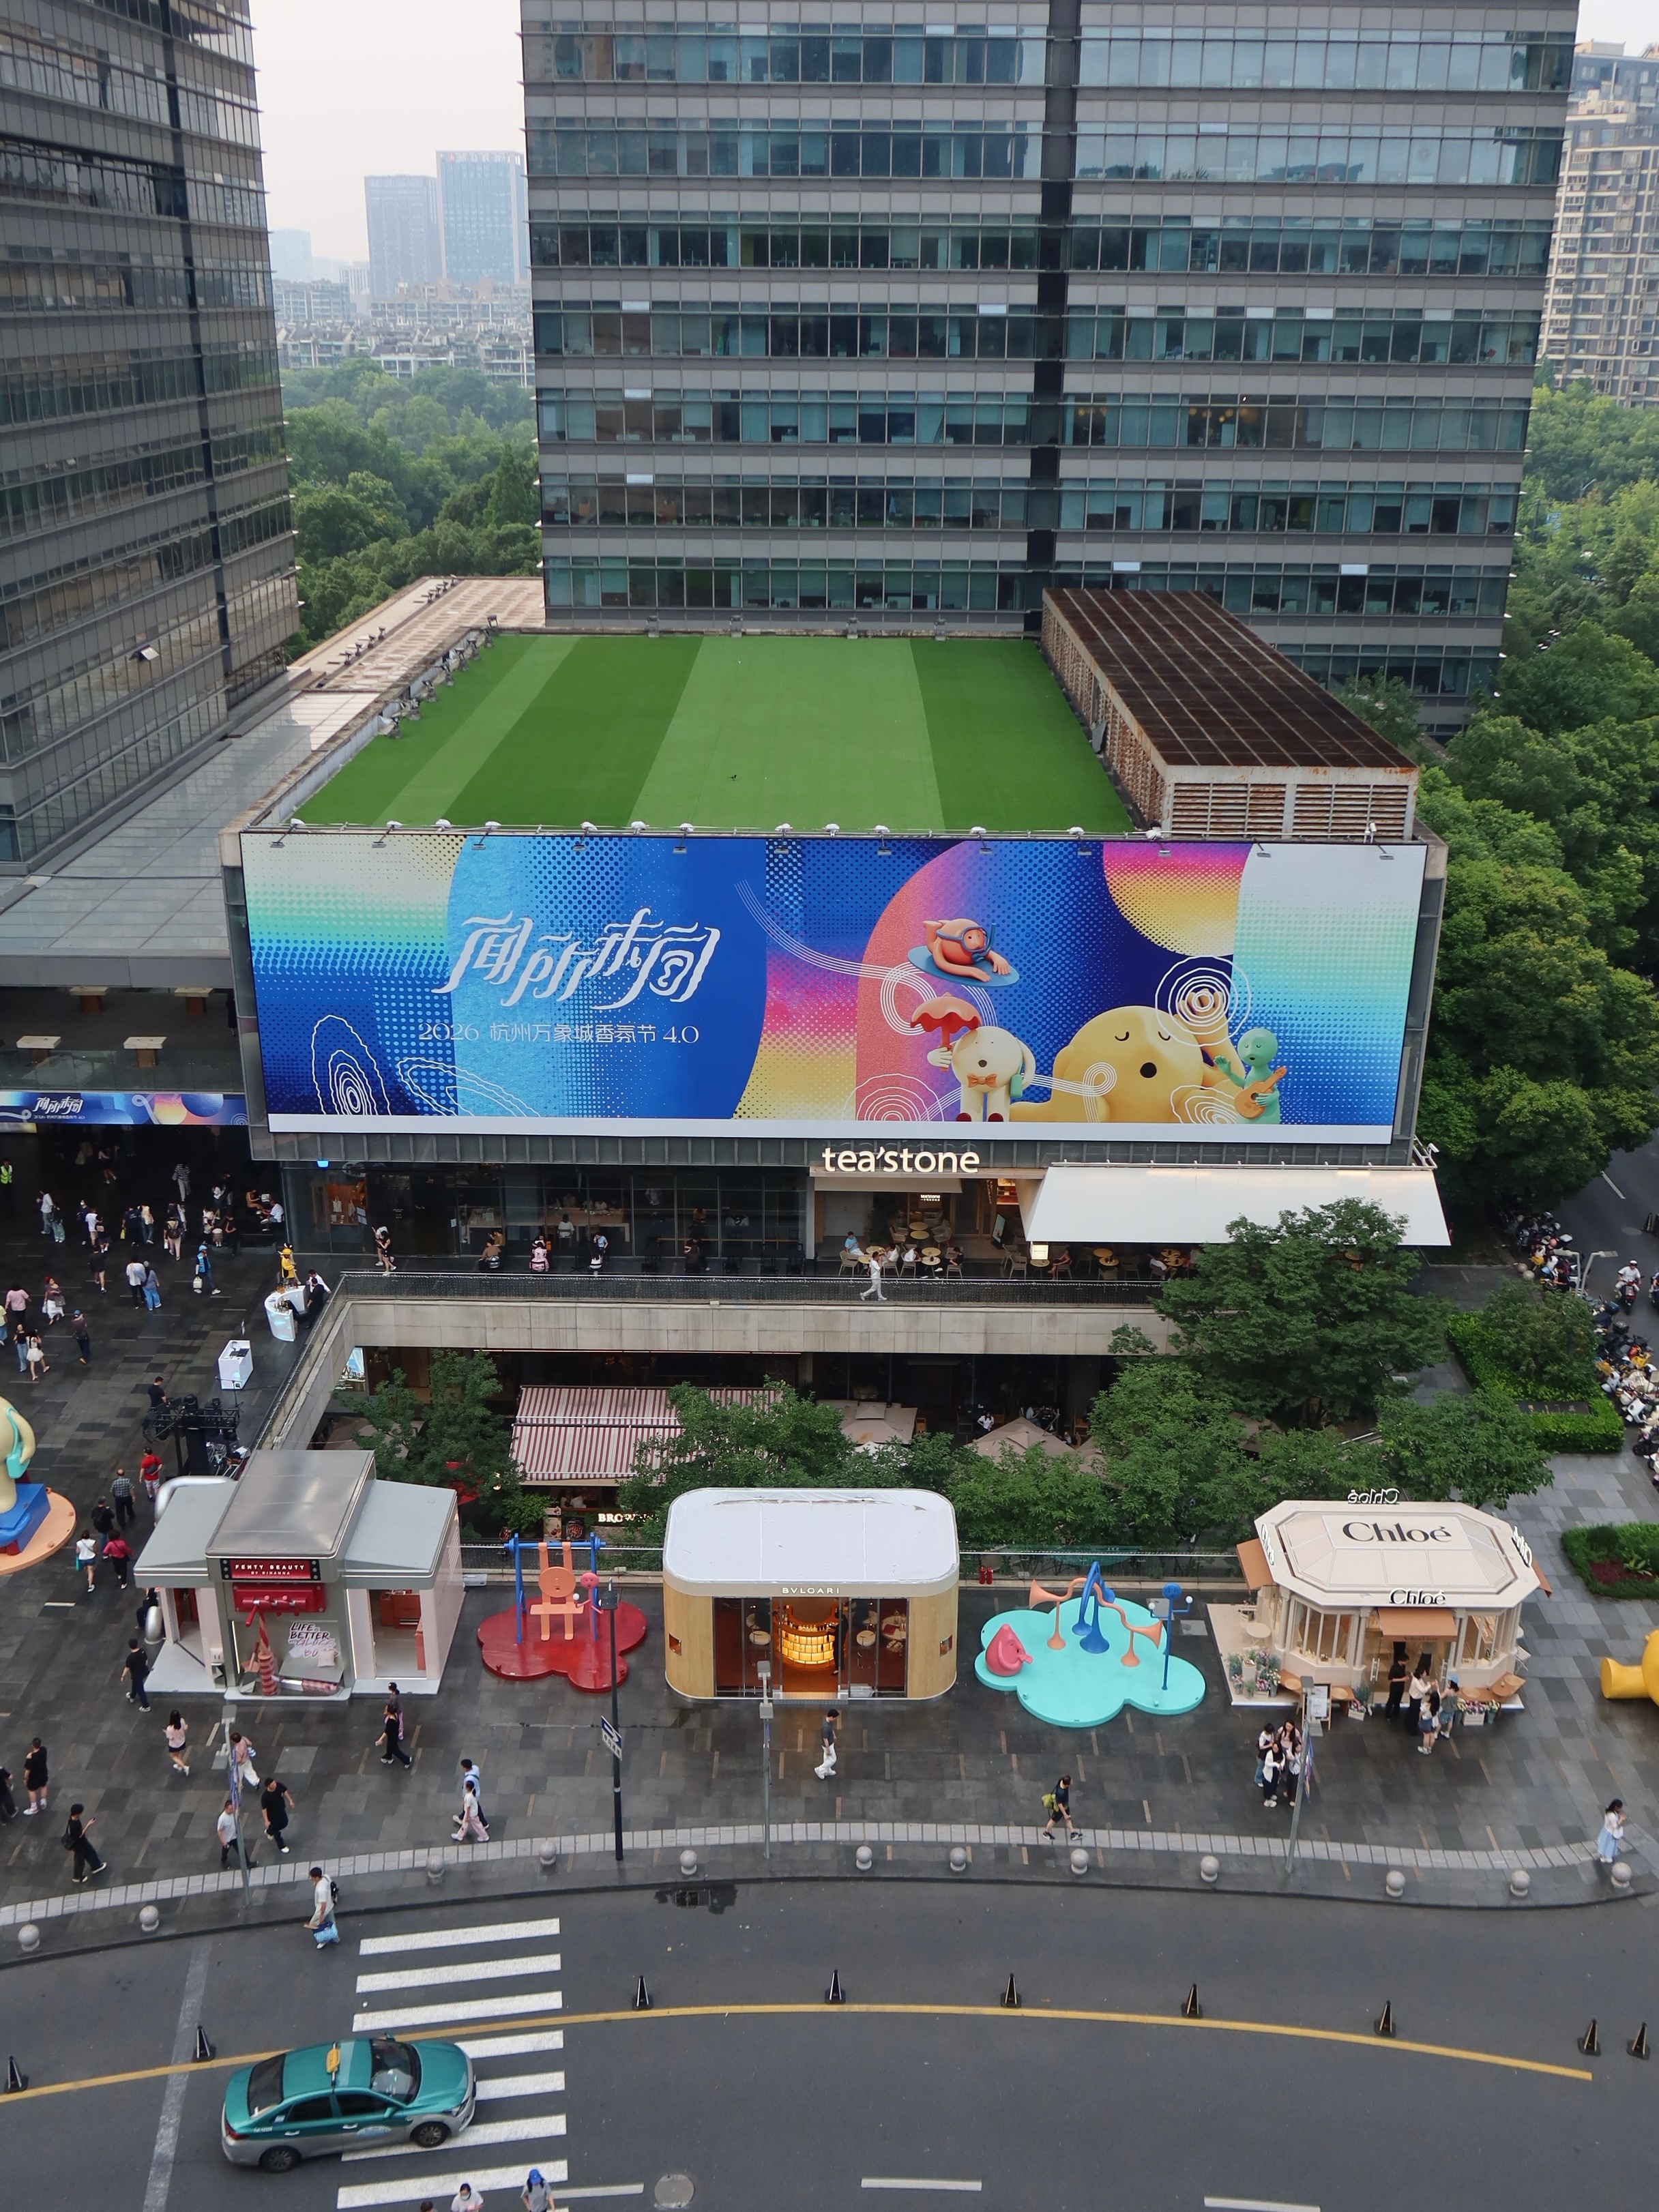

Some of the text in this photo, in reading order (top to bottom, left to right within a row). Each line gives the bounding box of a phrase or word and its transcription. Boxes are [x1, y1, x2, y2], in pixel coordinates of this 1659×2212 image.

[418, 1022, 700, 1044] 2026 杭州万象城香氛节 4.0
[821, 1146, 980, 1173] tea'stone
[1342, 1521, 1452, 1543] Chloé
[1389, 1587, 1447, 1605] Chloé
[290, 1632, 329, 1640] BETTER
[291, 1622, 314, 1632] LIFE
